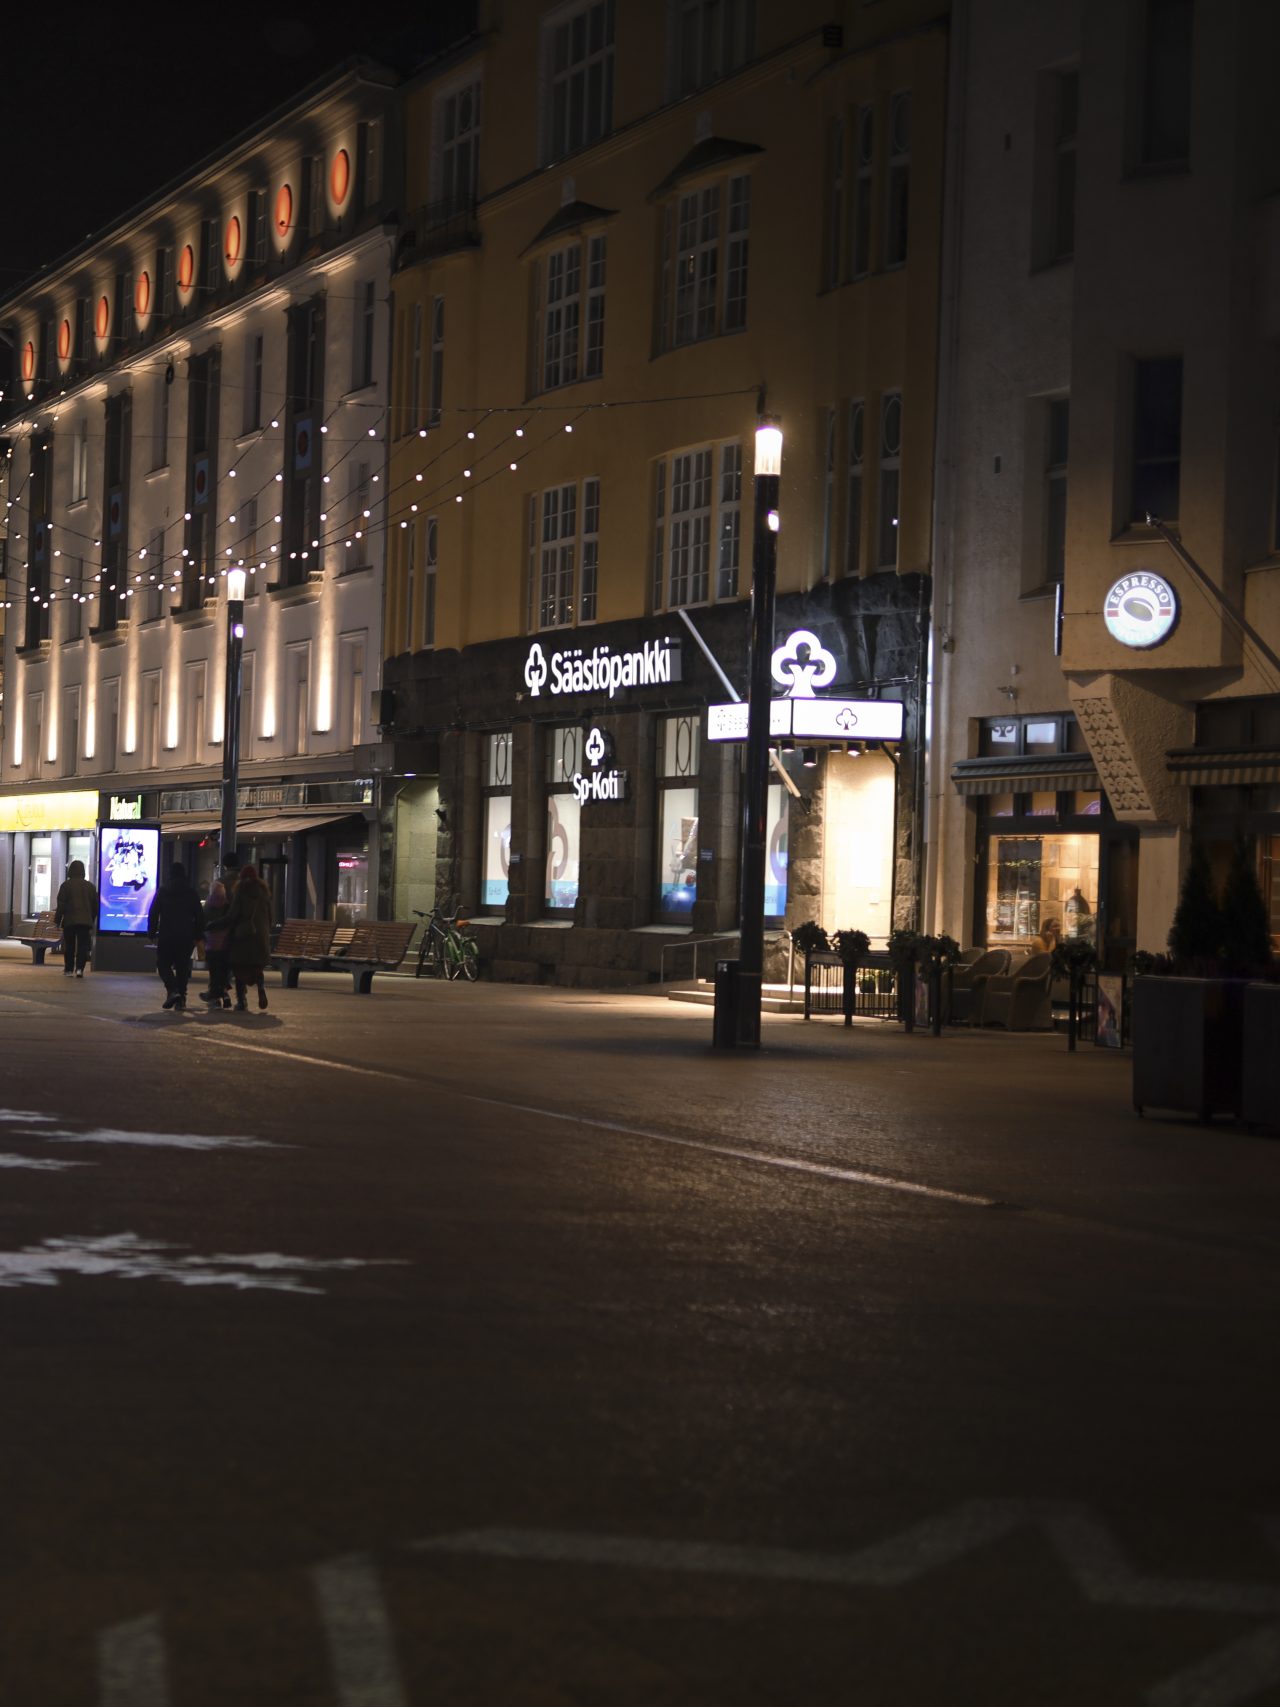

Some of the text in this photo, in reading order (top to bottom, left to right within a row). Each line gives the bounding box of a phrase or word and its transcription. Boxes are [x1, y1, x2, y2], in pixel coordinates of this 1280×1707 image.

[1110, 576, 1169, 604] ESPRESSO
[550, 636, 670, 699] Säästöpankki
[573, 770, 618, 806] Sp-Koti
